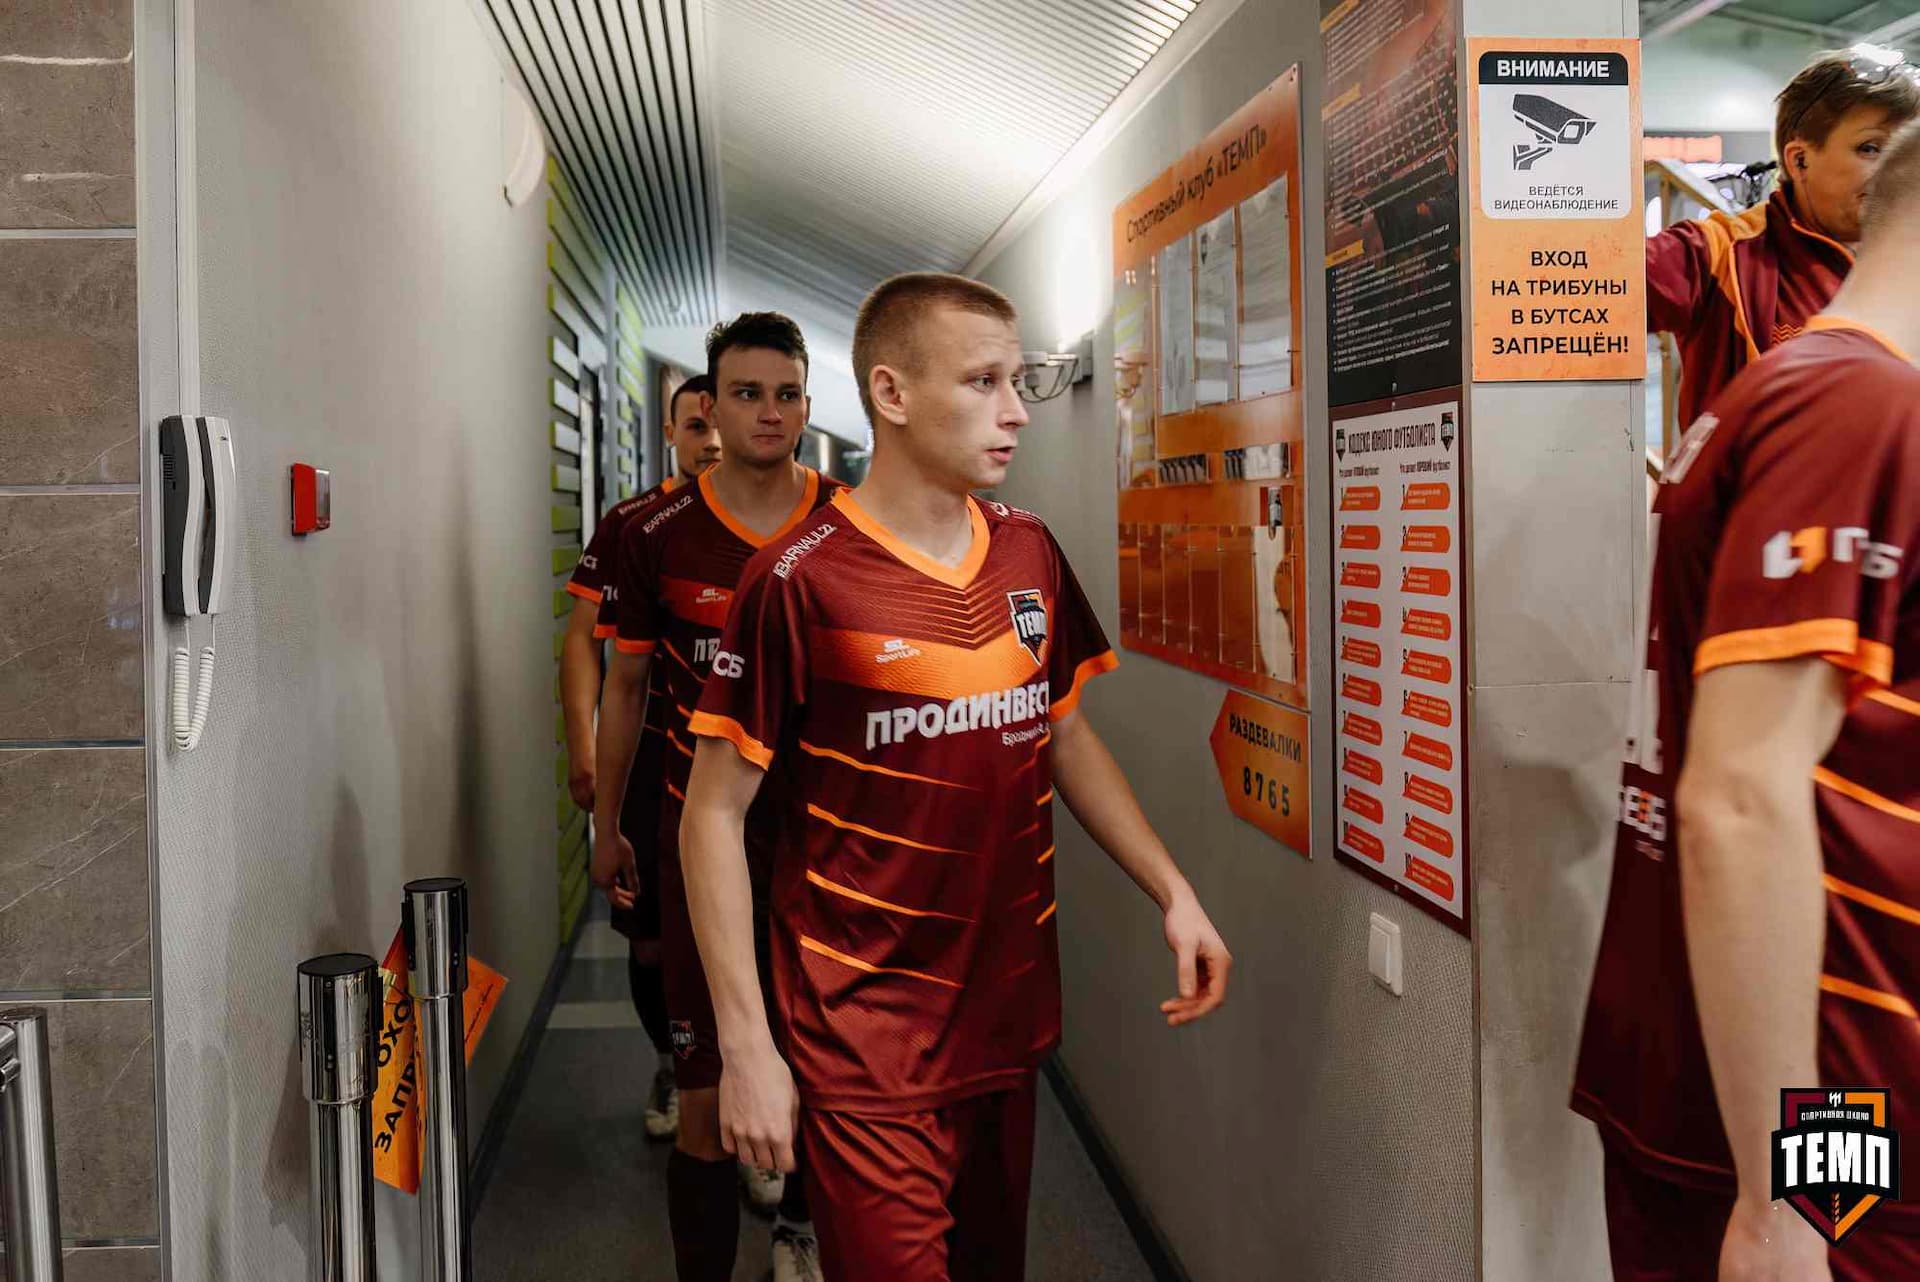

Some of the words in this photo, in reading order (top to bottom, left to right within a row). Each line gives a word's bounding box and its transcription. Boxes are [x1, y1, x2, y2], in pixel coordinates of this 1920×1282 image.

[1497, 59, 1610, 78] ВНИМАНИЕ
[1528, 184, 1584, 197] ВЕДЁТСЯ
[1494, 199, 1619, 211] ВИДЕОНАБЛЮДЕНИЕ
[1531, 250, 1588, 270] ВХОД
[1491, 280, 1521, 296] НА
[1526, 279, 1627, 296] ТРИБУНЫ
[1511, 309, 1524, 324] В
[1531, 308, 1609, 324] БУТСАХ
[1491, 332, 1629, 357] ЗАПРЕЩЁН!
[1229, 713, 1302, 763] РАЗДЕВАЛКИ
[374, 1052, 418, 1153] ЗАПР
